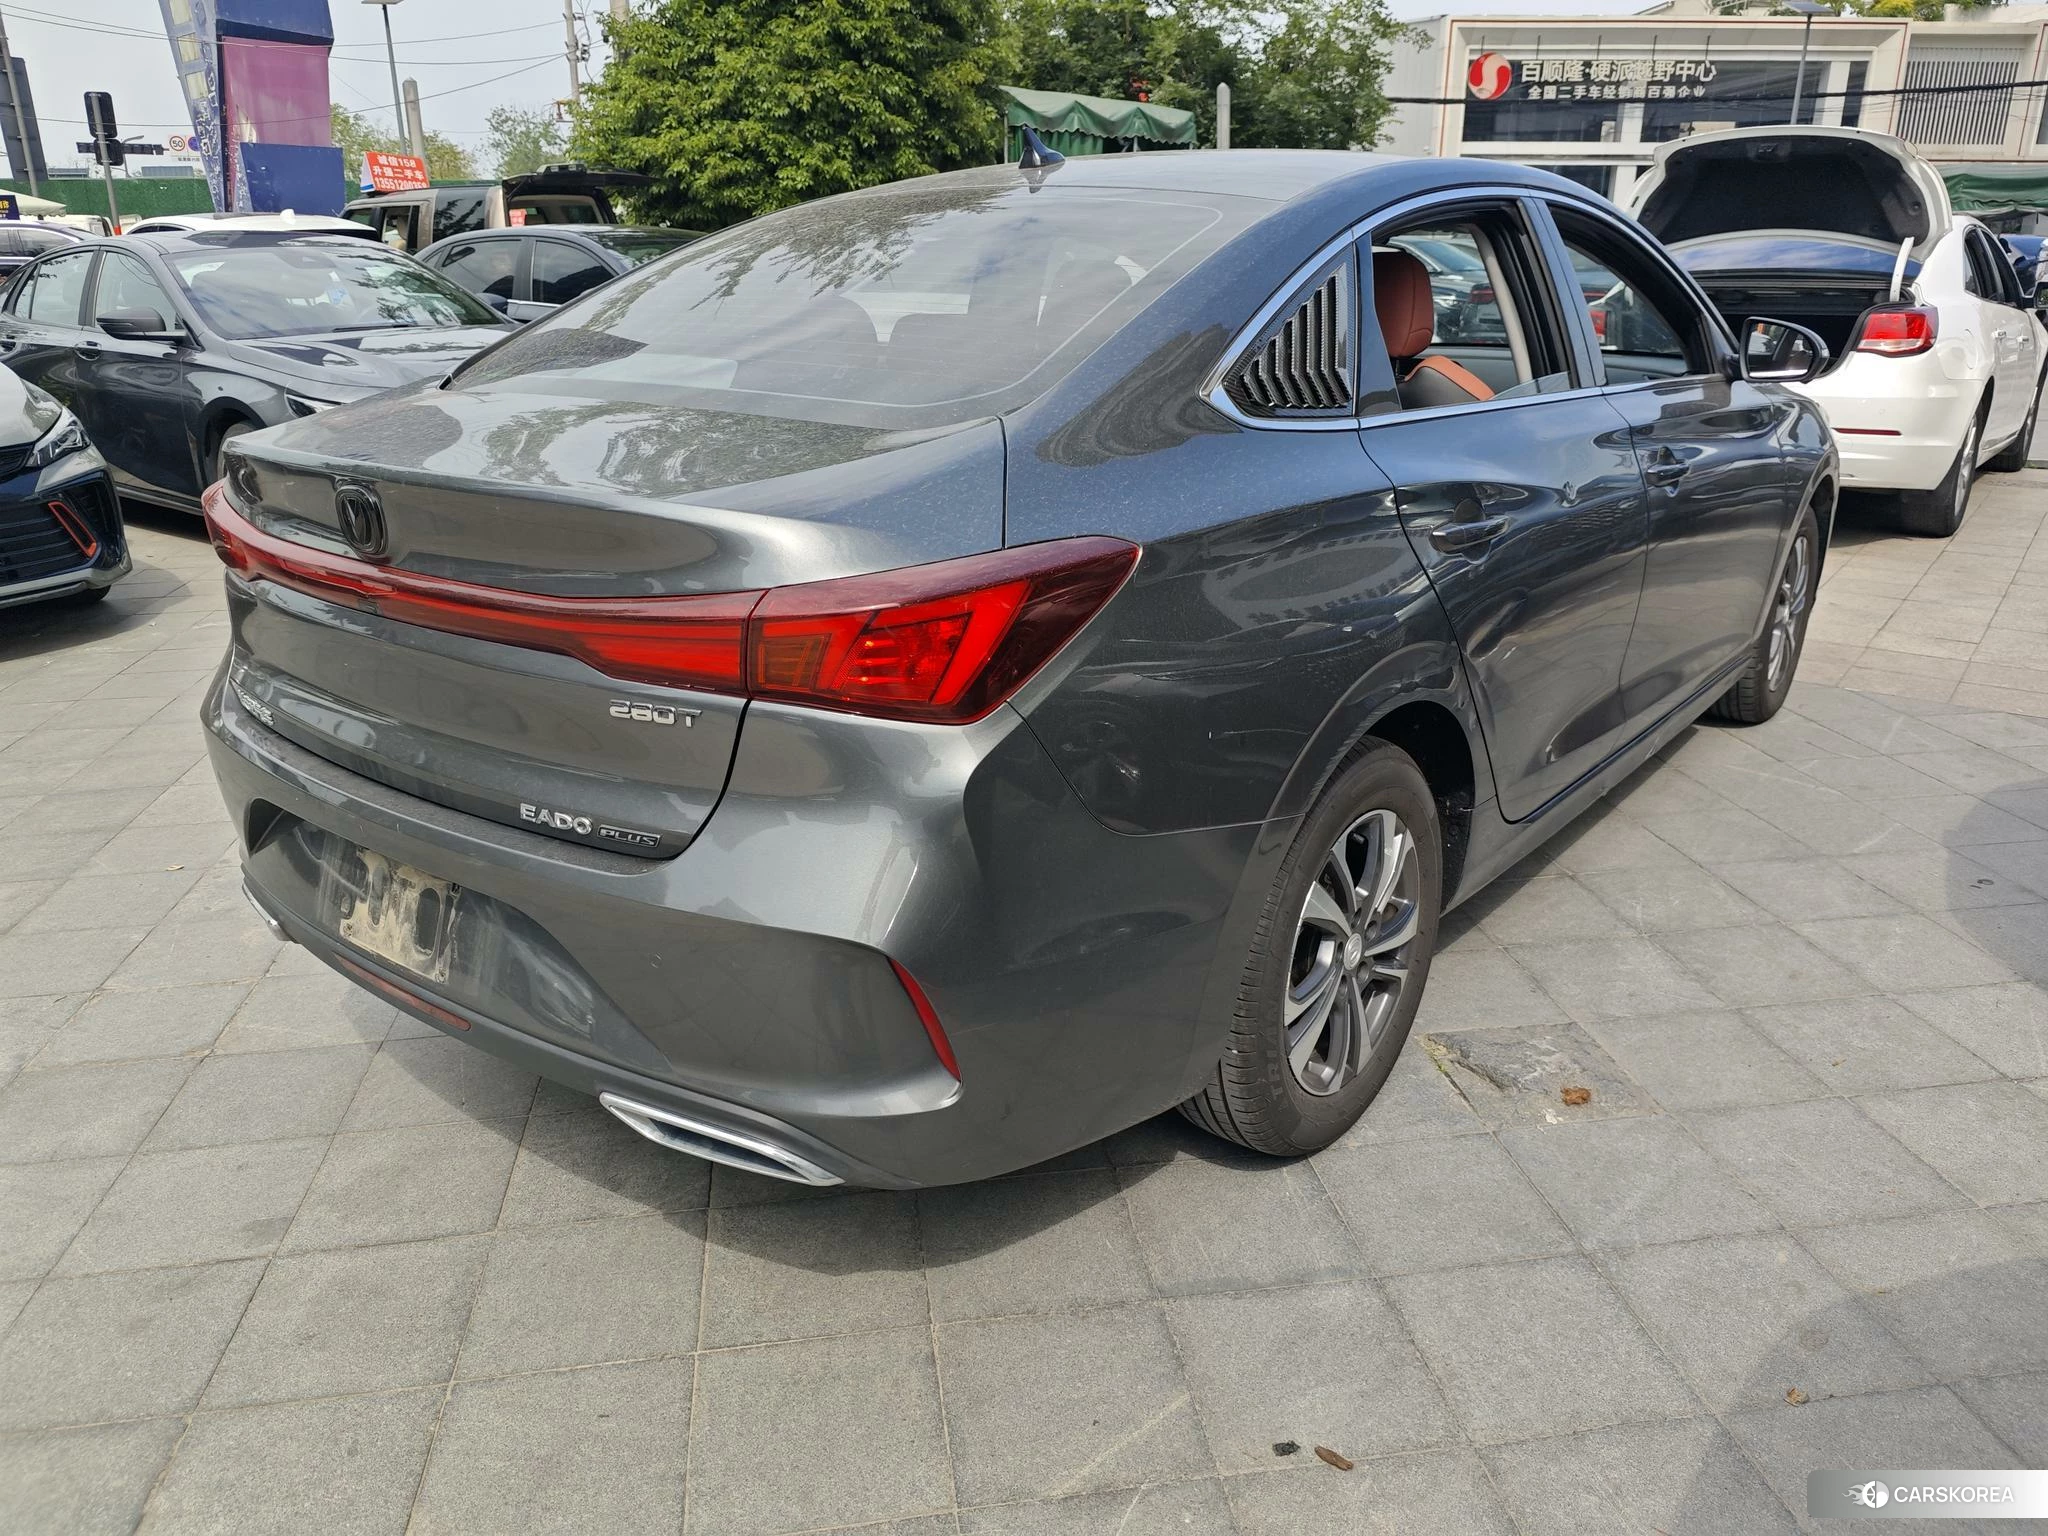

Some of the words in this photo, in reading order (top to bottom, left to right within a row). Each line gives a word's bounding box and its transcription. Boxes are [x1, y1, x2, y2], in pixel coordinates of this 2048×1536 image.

[1527, 84, 1706, 100] 全国二手车经销商百强企业
[172, 139, 184, 148] 50
[520, 802, 593, 836] EADO
[599, 827, 658, 847] PLUS
